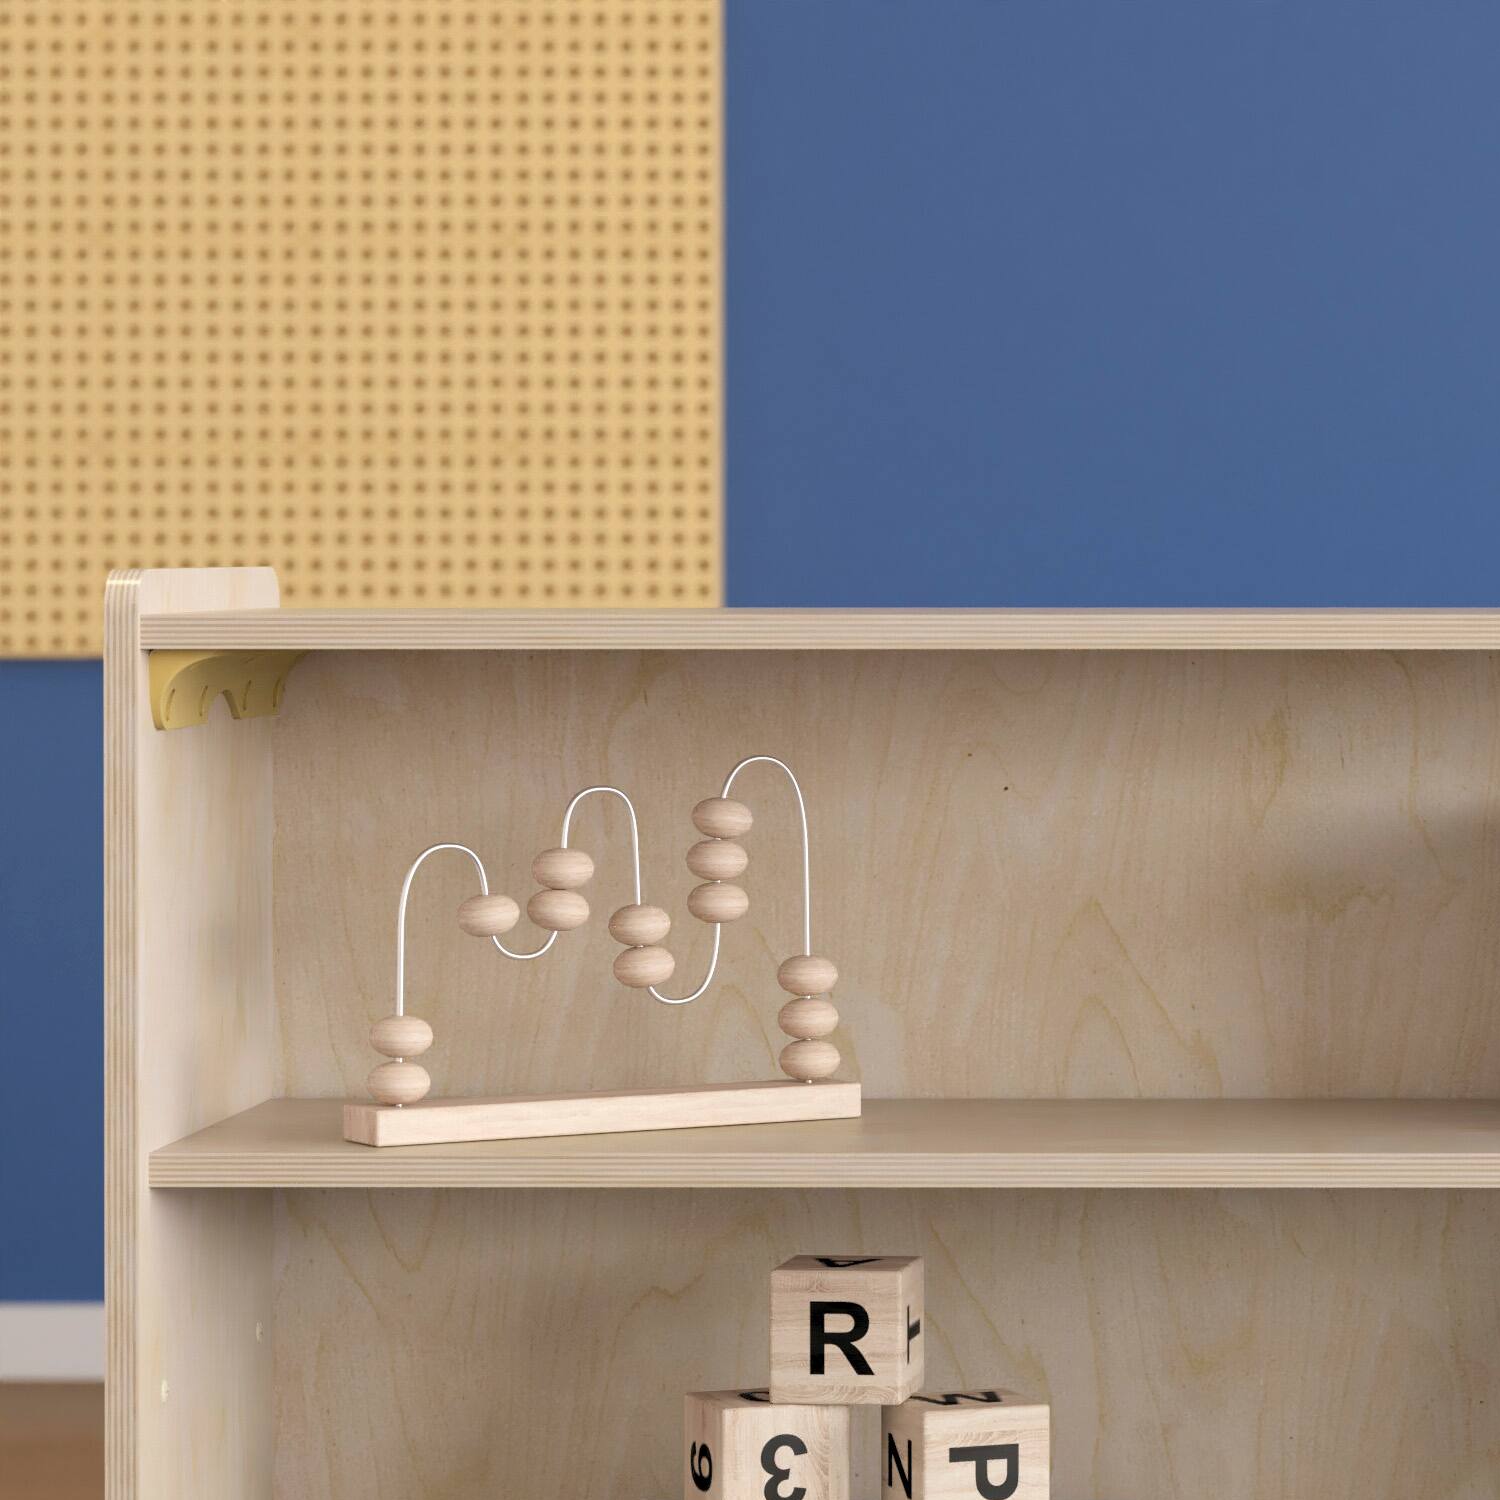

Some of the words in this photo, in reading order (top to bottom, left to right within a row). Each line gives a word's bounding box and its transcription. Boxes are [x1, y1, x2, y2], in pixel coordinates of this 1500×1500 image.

[810, 1301, 875, 1375] R
[888, 1433, 912, 1500] N
[949, 1444, 1019, 1500] P
